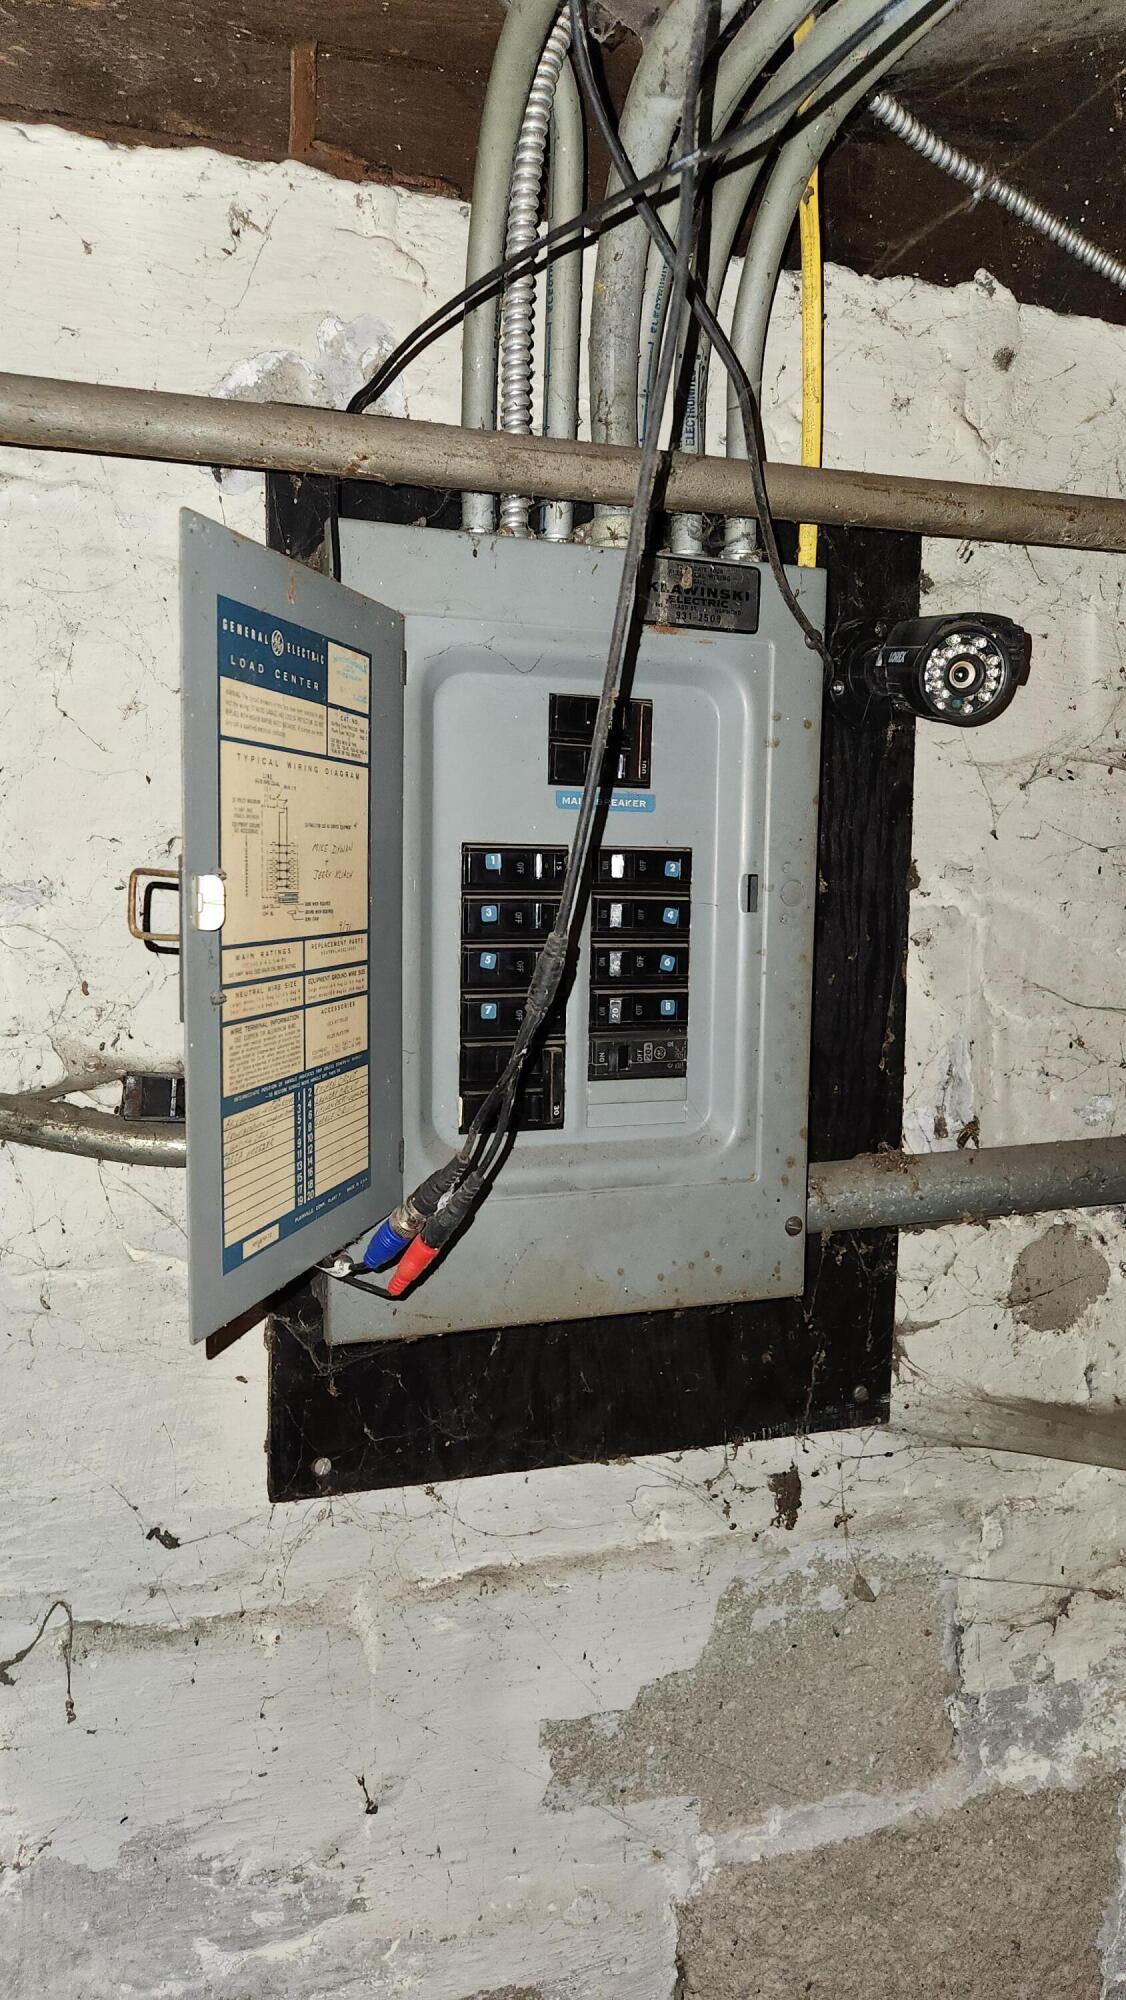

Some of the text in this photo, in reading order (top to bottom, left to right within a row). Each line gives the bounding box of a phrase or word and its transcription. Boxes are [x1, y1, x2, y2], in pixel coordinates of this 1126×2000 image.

[668, 595, 729, 608] ELECTRIC
[222, 618, 325, 665] GENERAL ELECTRIC
[888, 651, 908, 662] LOREX
[230, 655, 319, 691] LOAD CENTER
[237, 752, 360, 780] TYPICAL WIRING DIAGRAM
[562, 796, 584, 806] MAI
[311, 842, 328, 852] MIKE
[490, 855, 495, 865] 1
[669, 863, 676, 872] 2
[485, 907, 492, 917] 3
[667, 910, 674, 919] 4
[484, 955, 491, 964] 5
[664, 957, 671, 966] 6
[485, 1005, 492, 1015] 7
[611, 1007, 619, 1018] 20
[599, 1052, 605, 1062] ON
[307, 1087, 313, 1097] 2
[307, 1099, 312, 1108] 4
[296, 1104, 301, 1114] 3
[553, 1105, 560, 1116] 30
[296, 1115, 301, 1124] 5
[307, 1111, 313, 1120] 6
[296, 1127, 301, 1136] 7
[307, 1123, 313, 1132] 8
[296, 1138, 301, 1148] 9
[307, 1133, 313, 1143] 10
[296, 1150, 302, 1158] 11
[307, 1145, 313, 1154] 12
[296, 1161, 302, 1170] 13
[307, 1157, 313, 1166] 14
[307, 1167, 313, 1177] 16
[296, 1173, 302, 1182] 15
[307, 1179, 313, 1189] 18
[296, 1185, 302, 1194] 17
[306, 1191, 314, 1200] 20
[297, 1196, 303, 1206] 19
